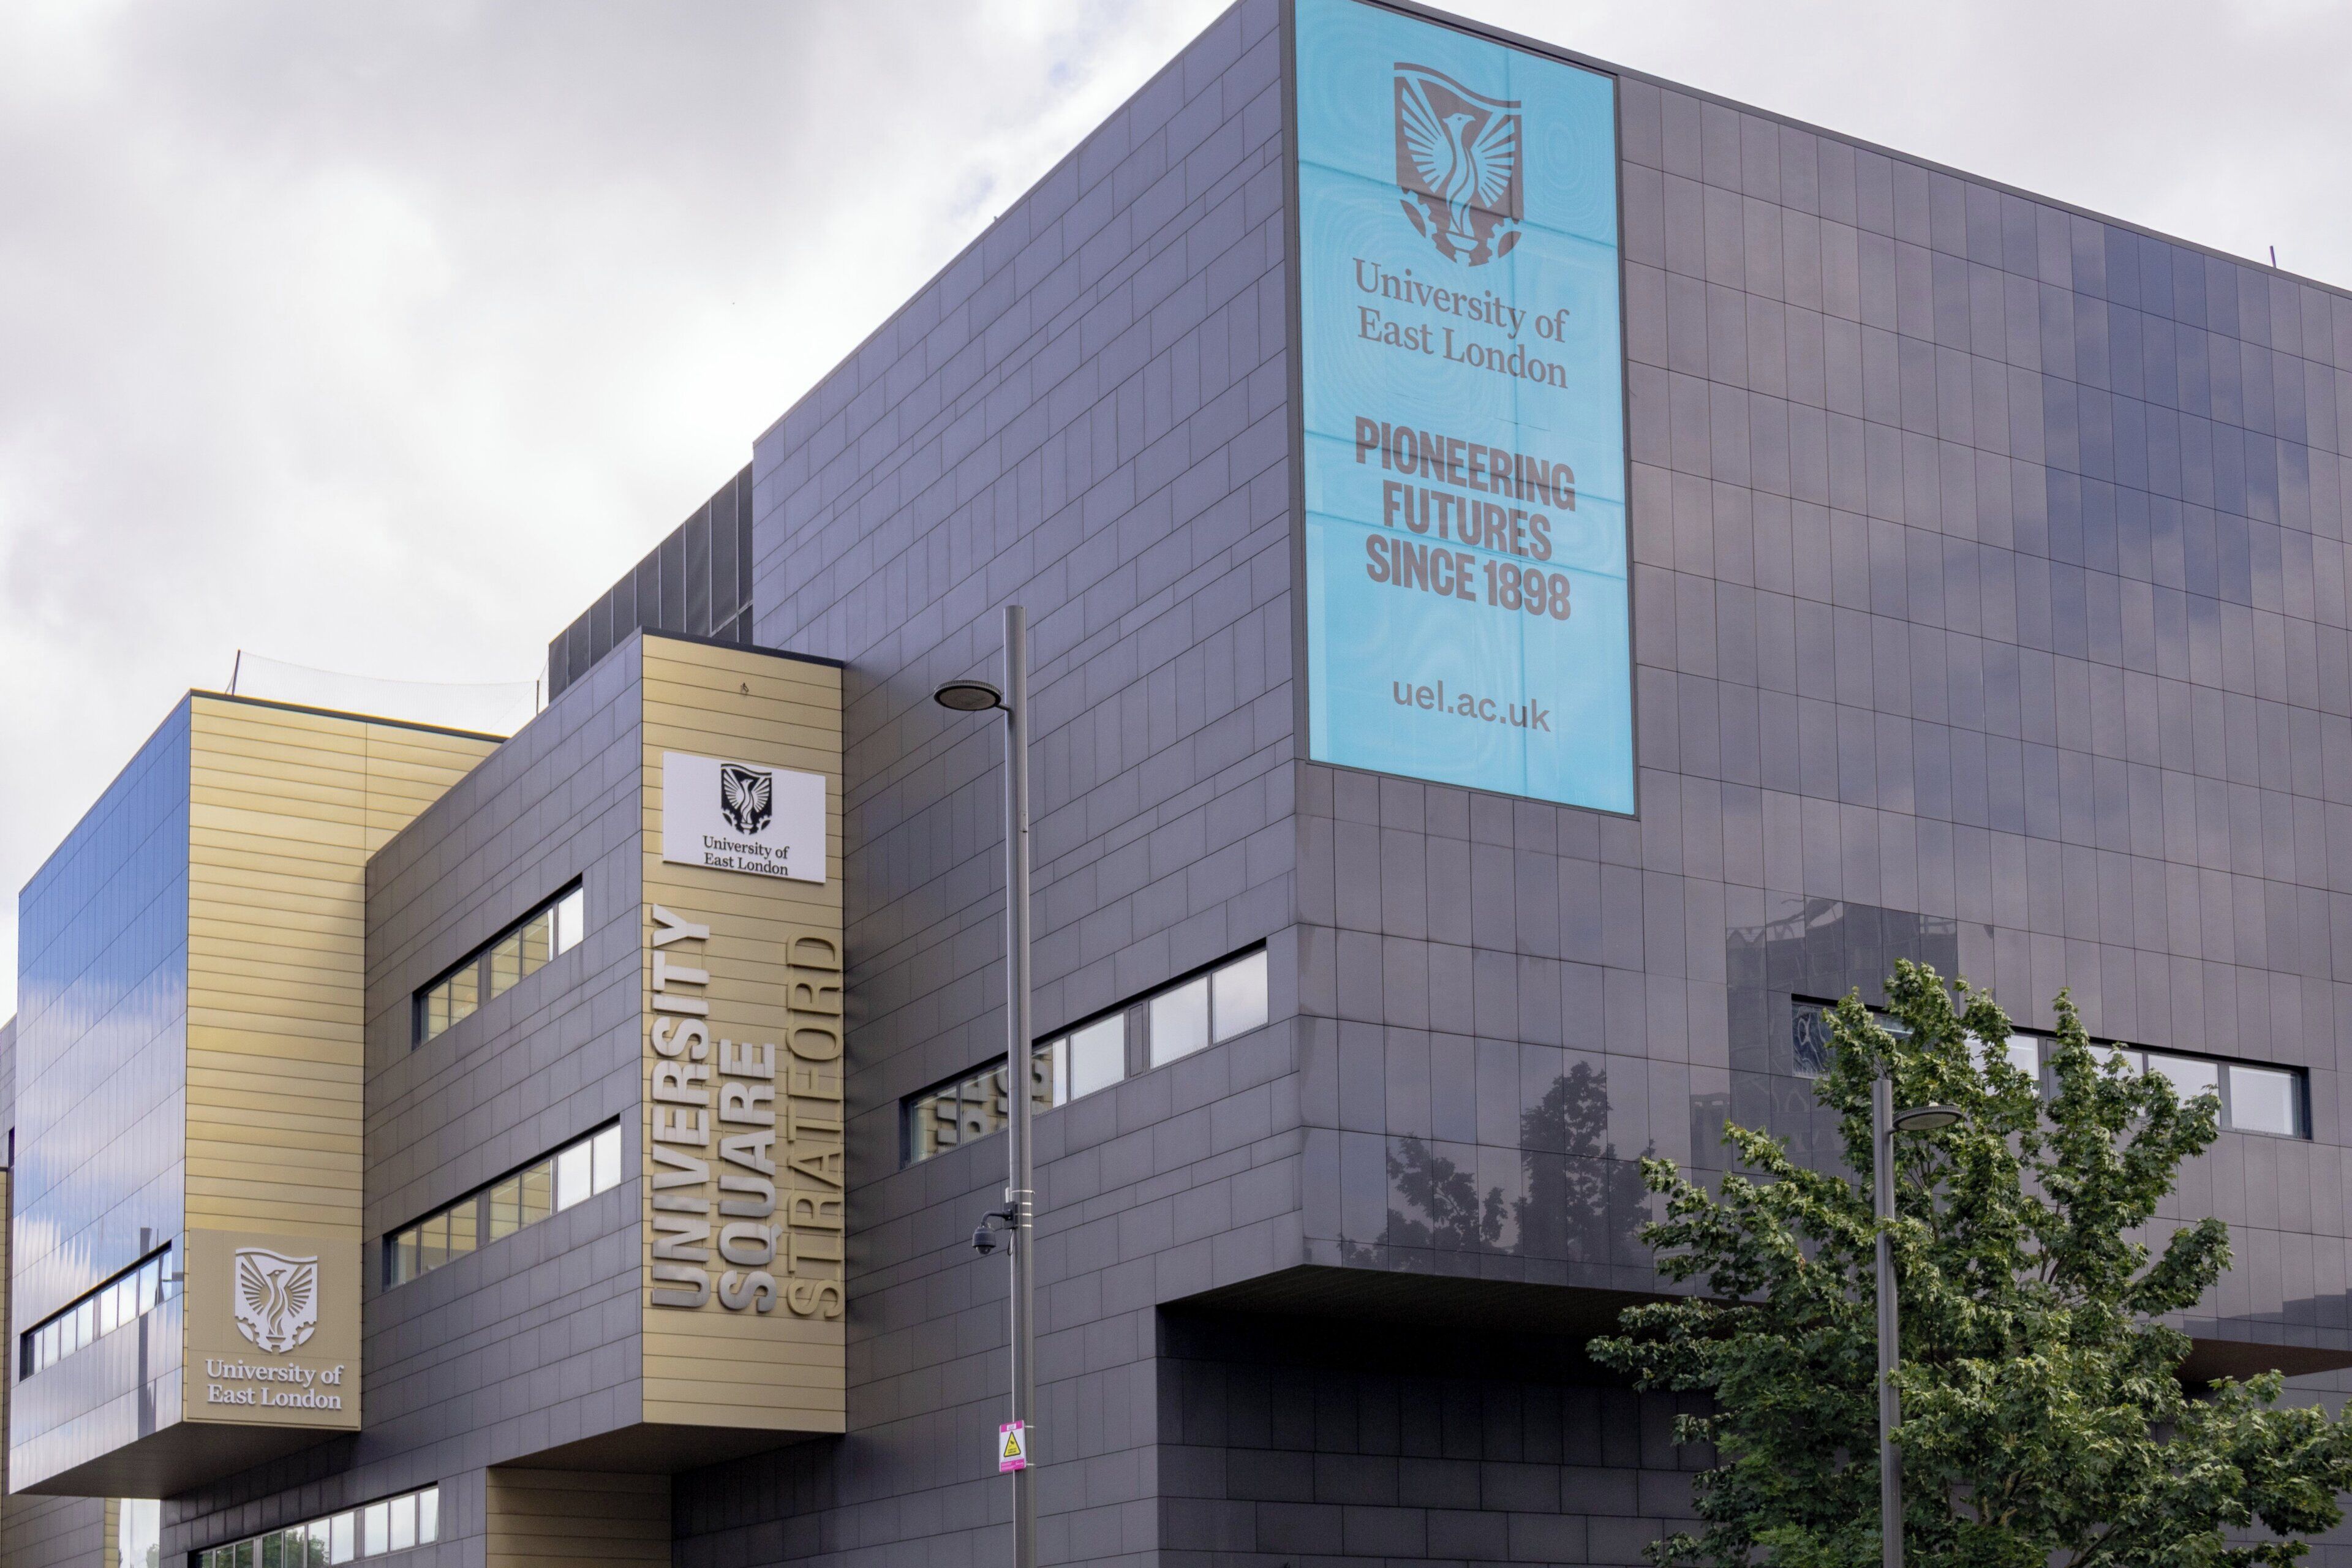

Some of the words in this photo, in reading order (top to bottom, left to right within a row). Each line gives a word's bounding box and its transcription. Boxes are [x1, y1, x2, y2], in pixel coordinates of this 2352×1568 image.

[1353, 257, 1526, 339] University
[1536, 309, 1570, 343] of
[1357, 306, 1434, 355] East
[1442, 327, 1569, 389] London
[1355, 415, 1576, 512] PIONEERING
[1382, 479, 1553, 562] FUTURES
[1366, 533, 1476, 602] SINCE
[1483, 559, 1572, 621] 1898
[1393, 679, 1551, 733] uel.ac.uk
[703, 835, 772, 859] University
[775, 846, 790, 859] of
[704, 852, 734, 868] East
[737, 857, 789, 876] London
[652, 903, 710, 1308] UNIVERSITY
[786, 935, 845, 1319] STRATFORD
[718, 1038, 783, 1314] SQUARE
[205, 1359, 316, 1388] University
[320, 1365, 344, 1385] of
[207, 1384, 256, 1405] East
[260, 1387, 342, 1409] London
